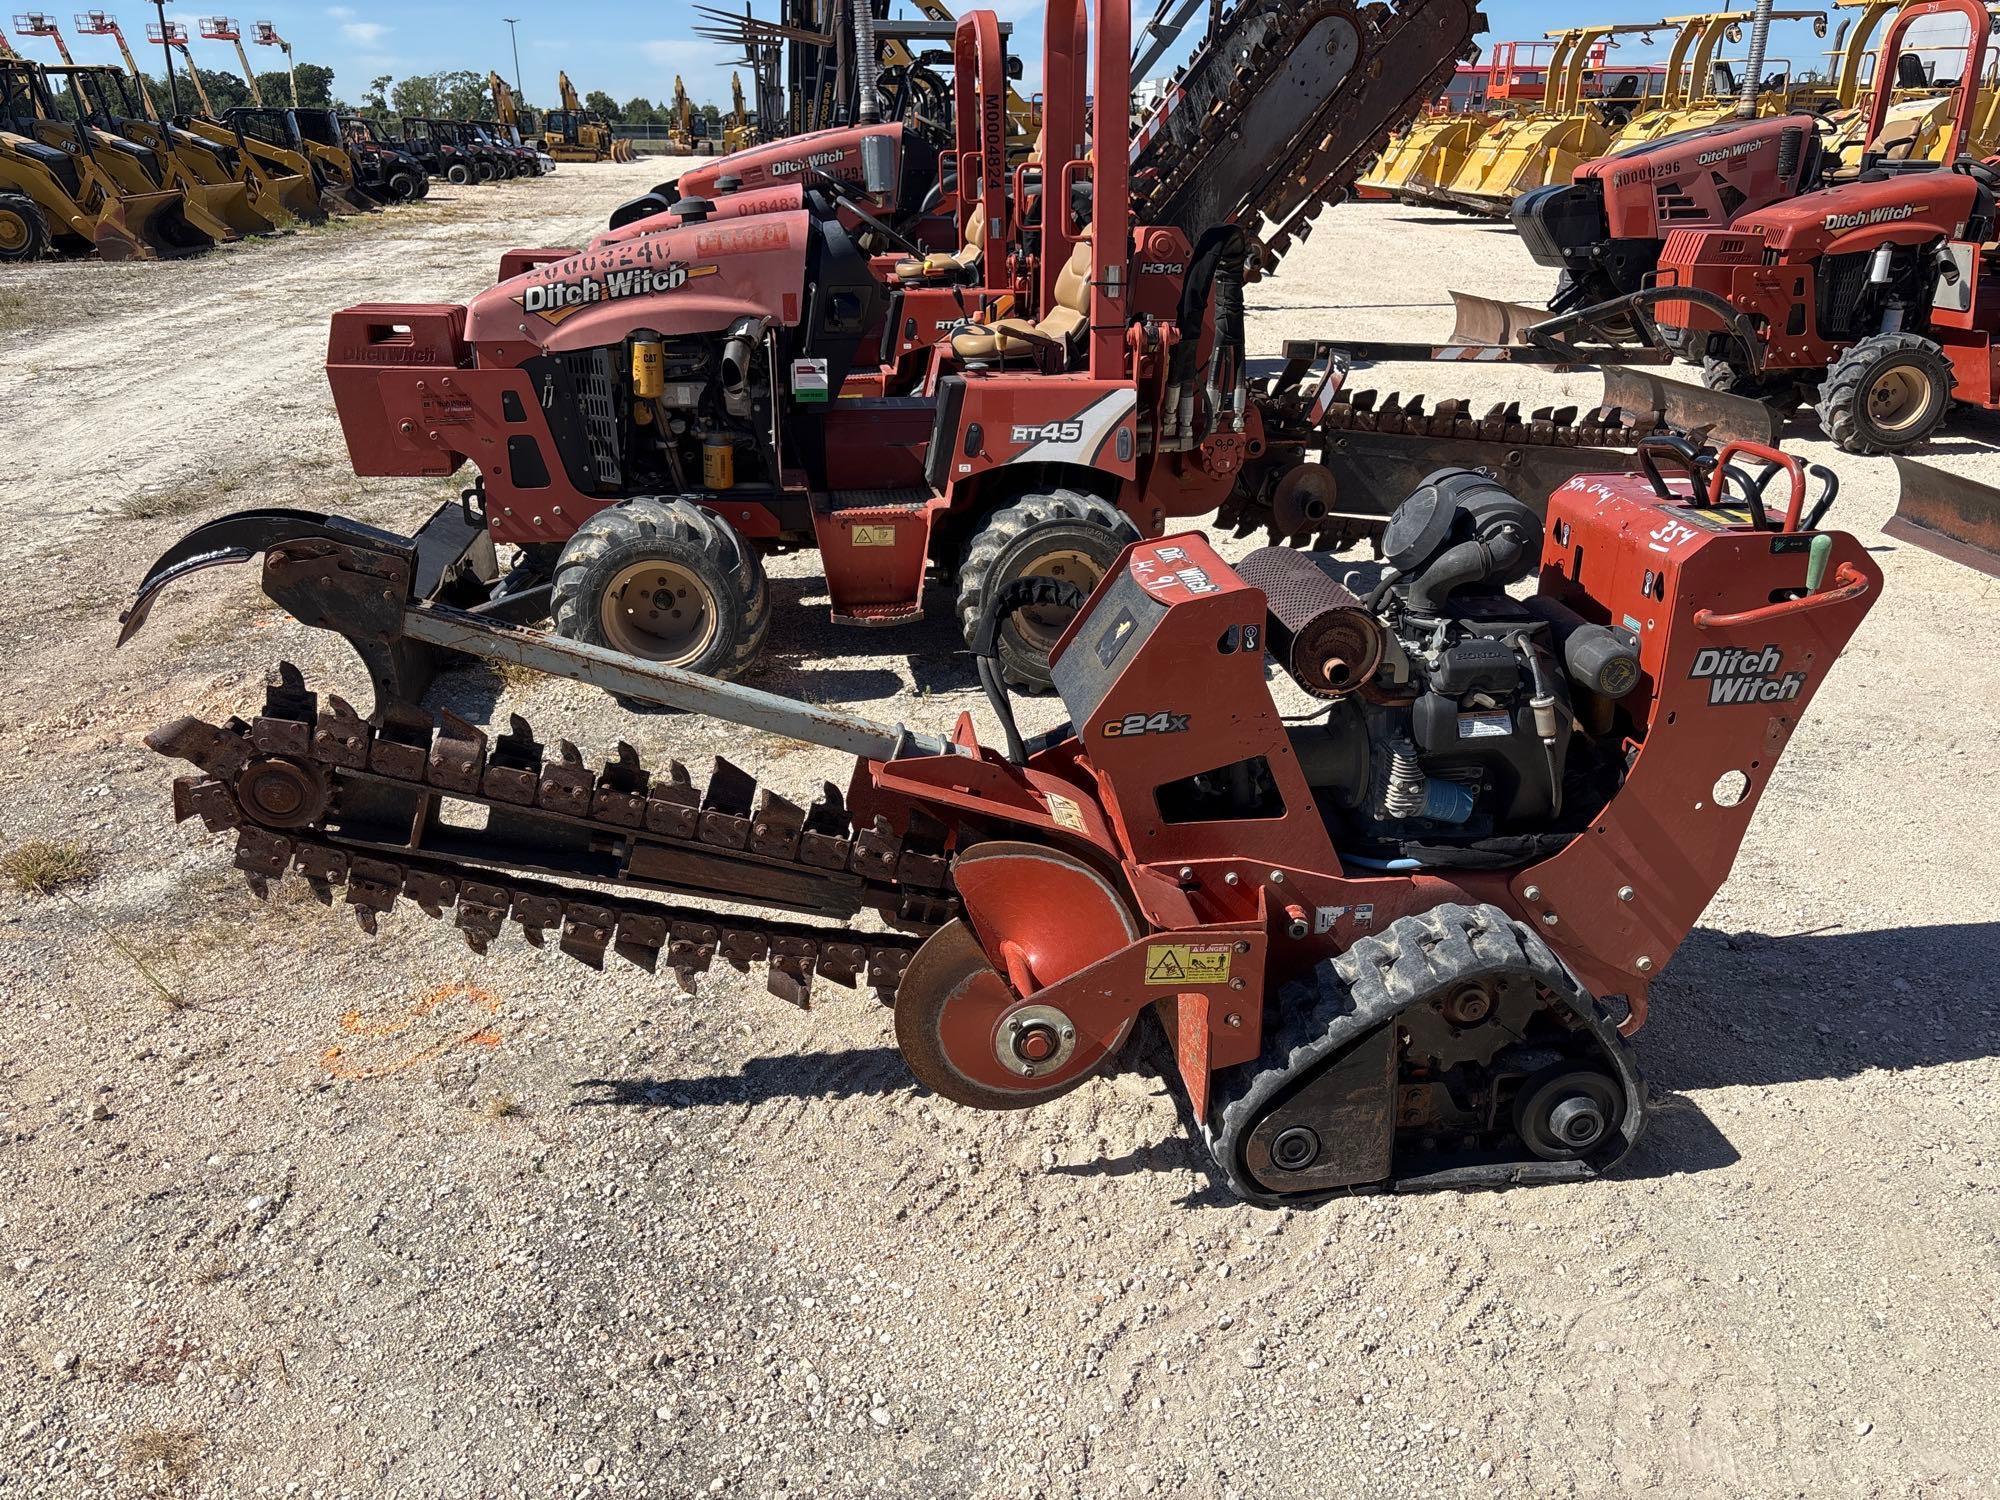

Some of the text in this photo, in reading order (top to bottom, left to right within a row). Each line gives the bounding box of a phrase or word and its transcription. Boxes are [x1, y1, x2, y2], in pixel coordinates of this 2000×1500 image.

[60, 139, 77, 152] 416
[142, 135, 157, 147] 416
[986, 94, 1001, 190] M0004824
[1698, 139, 1762, 165] Ditch Witch
[808, 149, 844, 169] Witch
[1825, 204, 1913, 230] Ditch Witch
[1141, 263, 1183, 274] H314
[525, 263, 687, 312] Ditch Witch
[643, 353, 657, 363] CAT
[1012, 423, 1081, 441] RT45
[1650, 520, 1699, 546] 354
[1691, 647, 1781, 677] Ditch
[1710, 674, 1801, 704] Witch
[1199, 945, 1229, 953] DANGER
